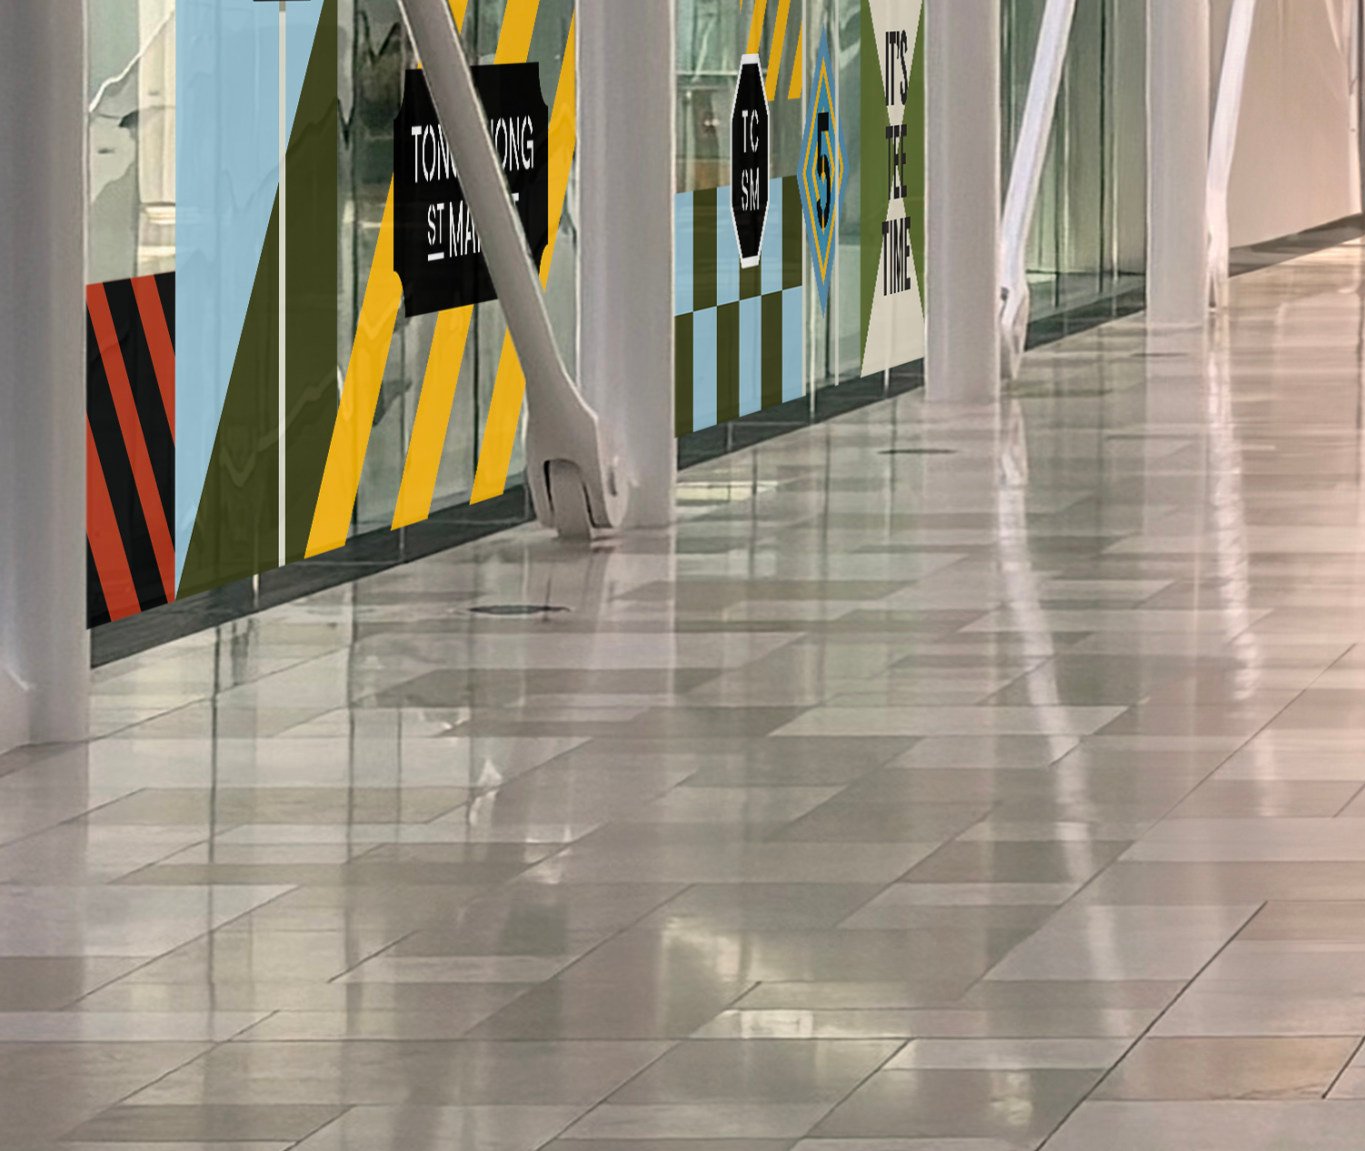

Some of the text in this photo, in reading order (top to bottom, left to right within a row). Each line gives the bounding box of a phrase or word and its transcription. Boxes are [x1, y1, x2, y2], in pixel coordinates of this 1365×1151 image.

[885, 30, 909, 106] IT'S
[411, 122, 459, 184] TON
[741, 109, 760, 153] TC
[885, 124, 908, 201] TEE
[741, 167, 760, 212] SM
[816, 111, 832, 230] 5
[882, 216, 912, 297] TIME
